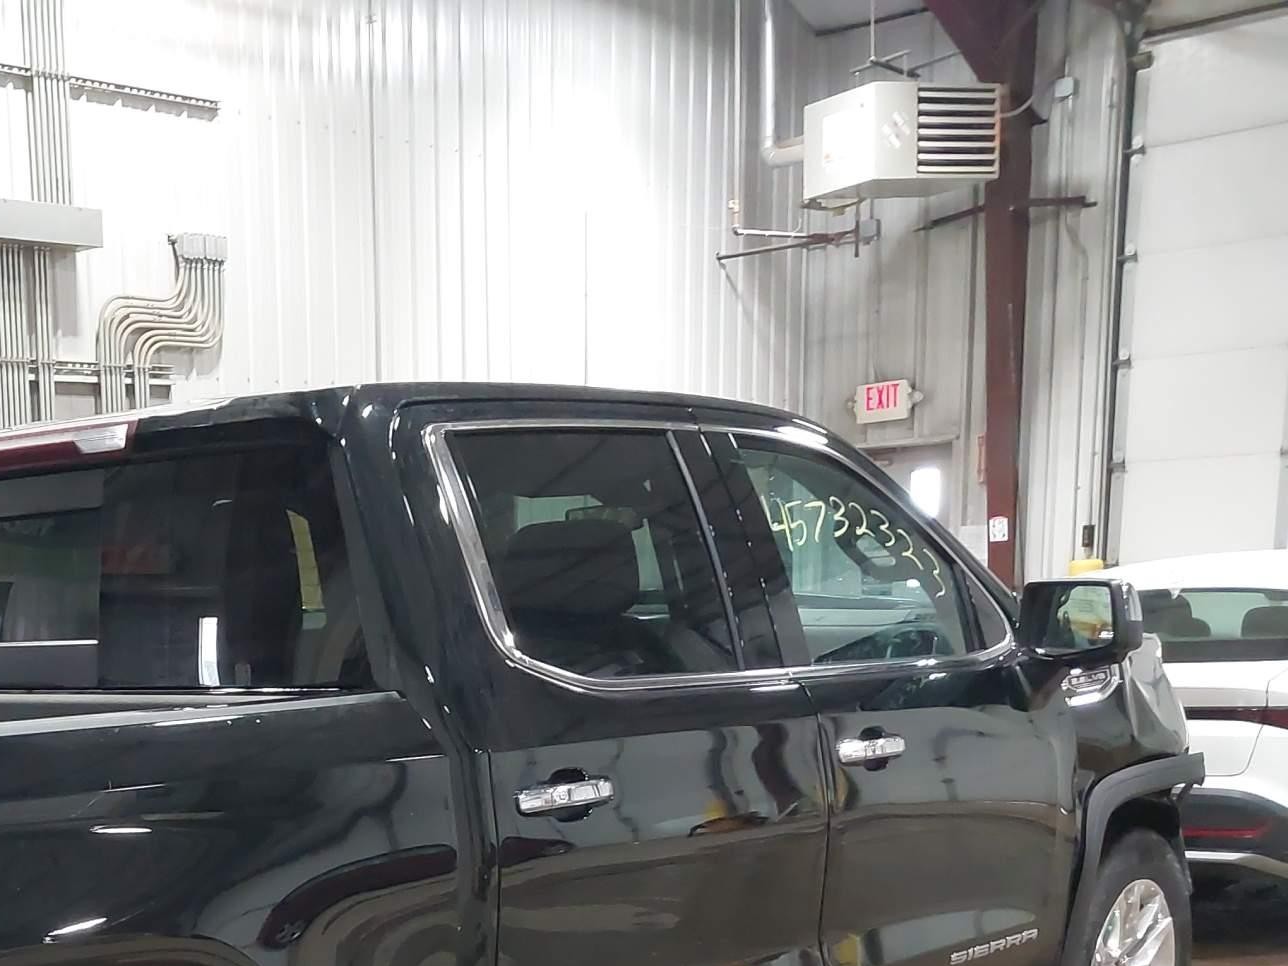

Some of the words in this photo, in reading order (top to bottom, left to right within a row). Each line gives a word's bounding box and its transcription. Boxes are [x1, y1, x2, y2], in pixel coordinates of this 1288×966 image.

[865, 383, 900, 411] EXIT
[761, 495, 946, 598] 45732323
[950, 928, 1039, 966] SIERRA
